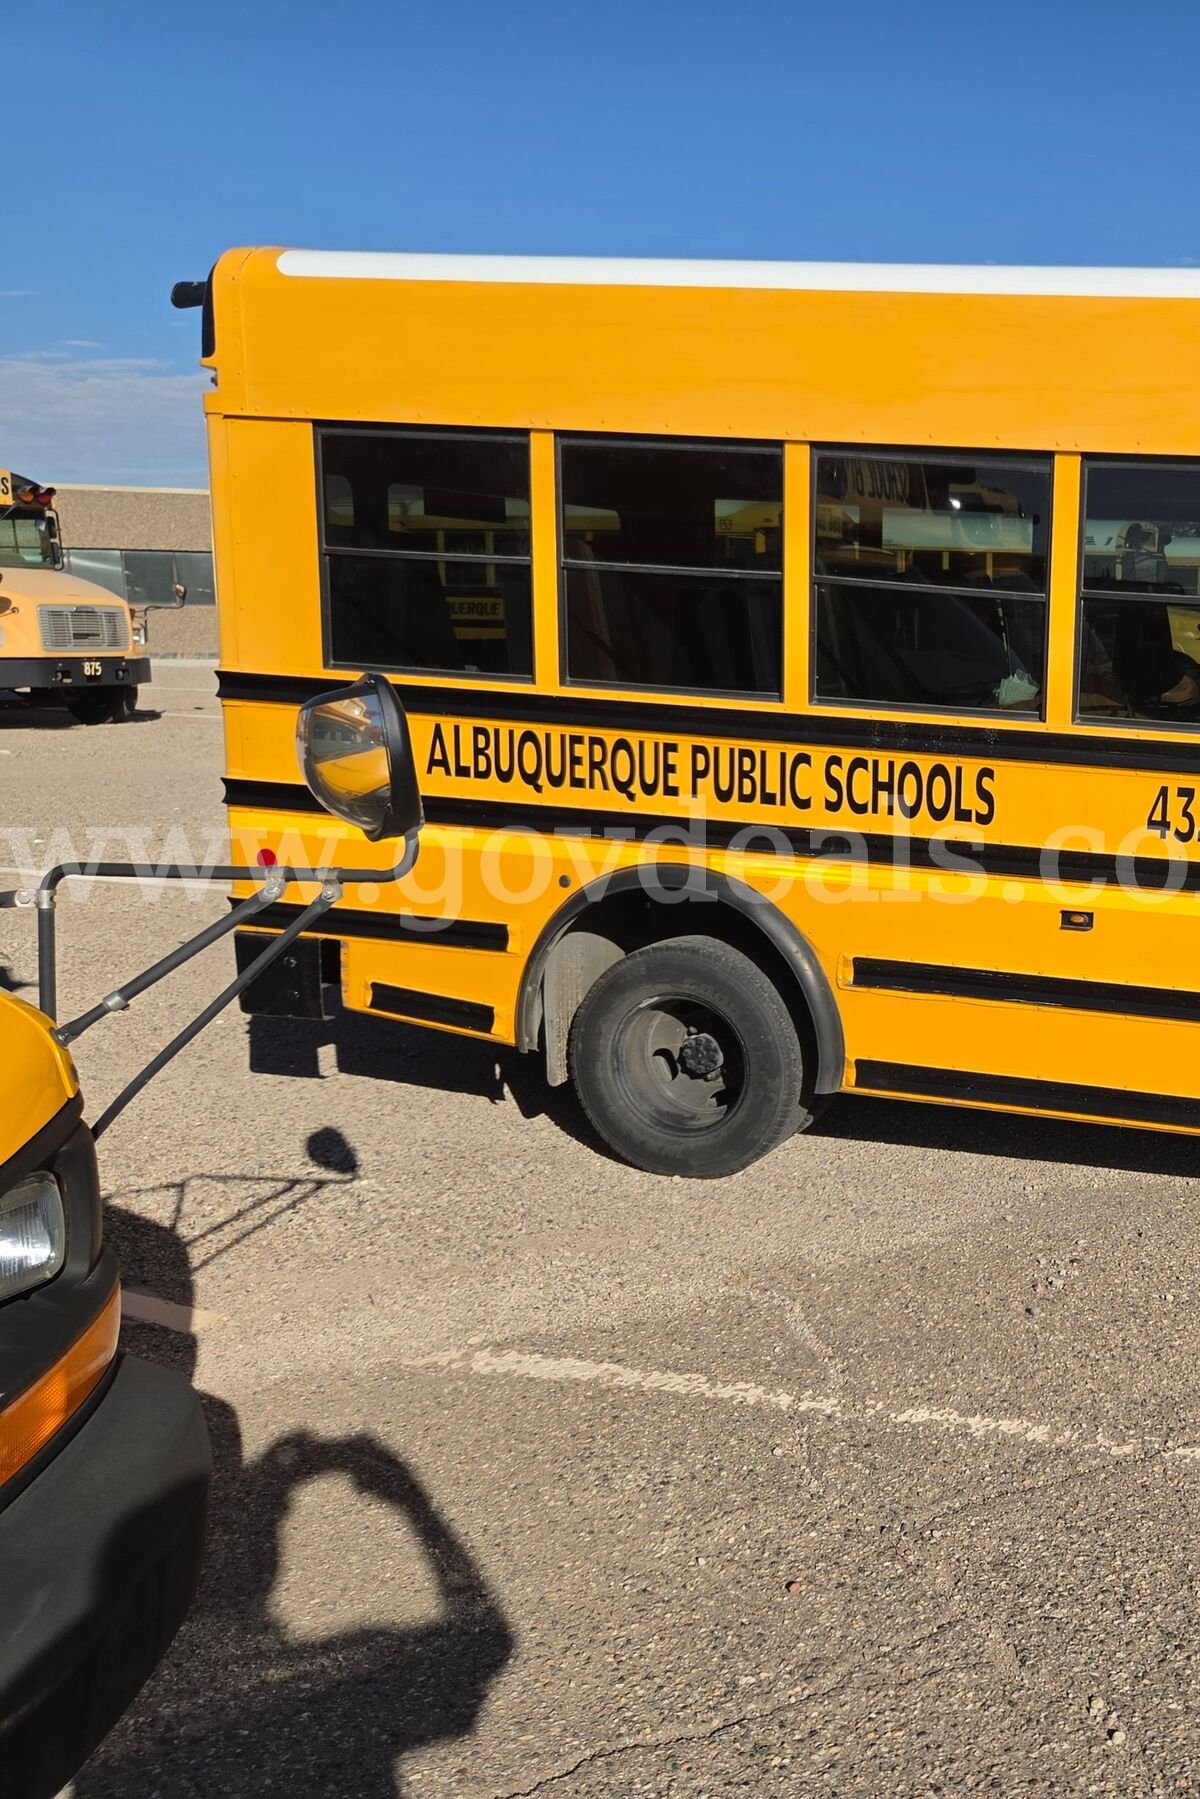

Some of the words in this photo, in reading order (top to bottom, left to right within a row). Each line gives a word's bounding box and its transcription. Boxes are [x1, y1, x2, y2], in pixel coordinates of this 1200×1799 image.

[84, 661, 102, 677] 875
[426, 722, 680, 801] ALBUQUERQUE
[690, 744, 813, 810] PUBLIC
[823, 754, 996, 826] SCHOOLS
